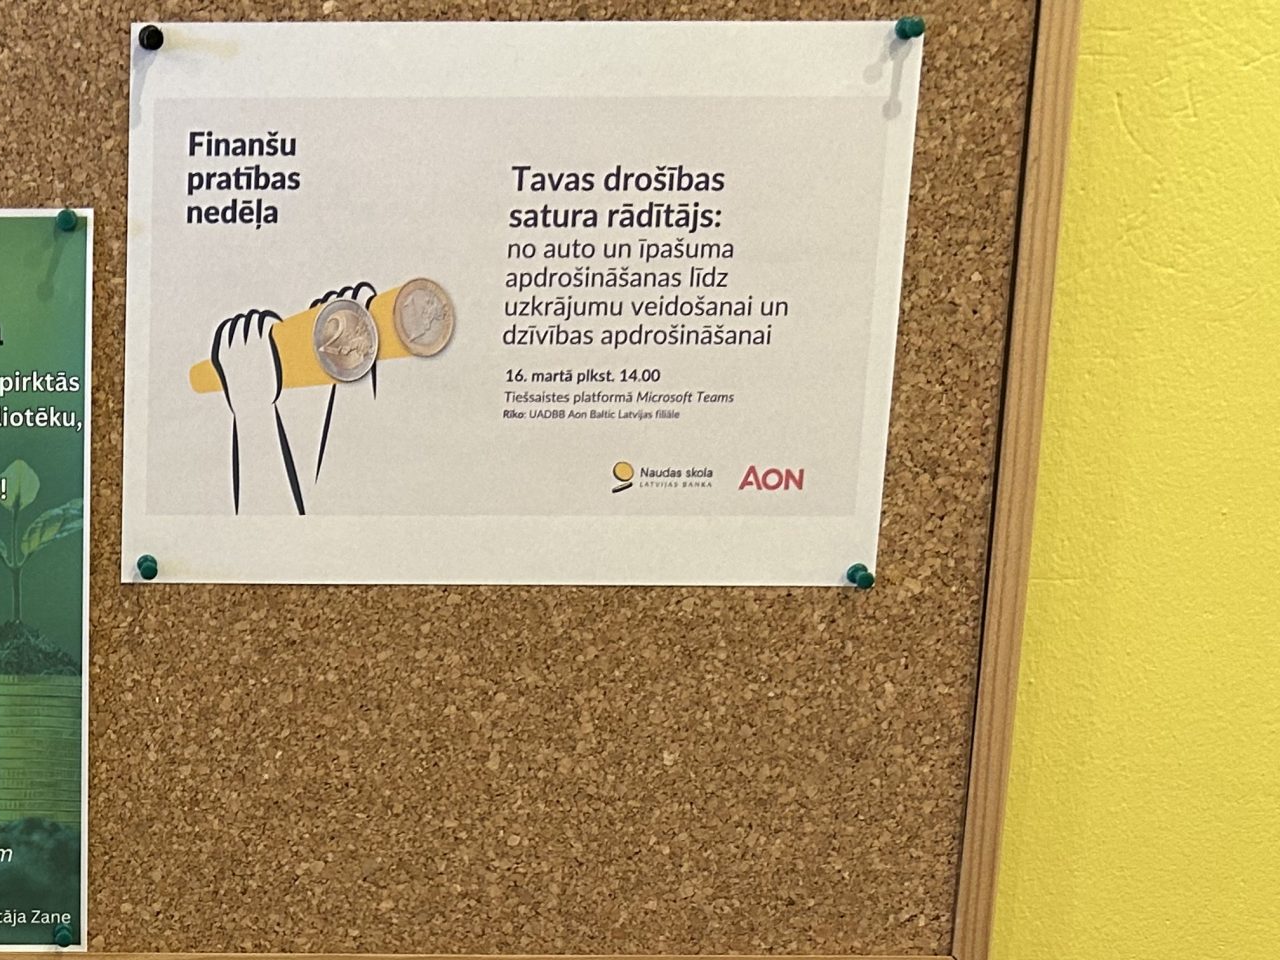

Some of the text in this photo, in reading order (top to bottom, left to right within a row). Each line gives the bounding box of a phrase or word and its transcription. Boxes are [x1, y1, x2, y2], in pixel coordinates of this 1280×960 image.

[188, 130, 298, 157] Finanšu
[187, 167, 301, 198] pratības
[513, 164, 726, 193] Tavas drošības
[186, 199, 279, 230] nedēļa
[508, 201, 722, 235] satura rādītājs:
[507, 237, 735, 266] no auto un īpašuma
[505, 265, 729, 296] apdrošināšanas līdz
[504, 294, 789, 324] uzkrājumu veidošanai un
[502, 322, 772, 353] dzīvības apdrošināšanai
[505, 369, 661, 385] 16. martā plkst. 14.00
[504, 390, 734, 405] Tiešsaistes platformā Microsoft Teams
[568, 410, 587, 419] Aon
[590, 410, 616, 419] Baltic
[618, 410, 653, 421] Latvijas
[655, 410, 681, 419] filiāle
[640, 467, 714, 478] Naudas skola
[738, 464, 805, 491] AON
[31, 910, 72, 925] Zane
